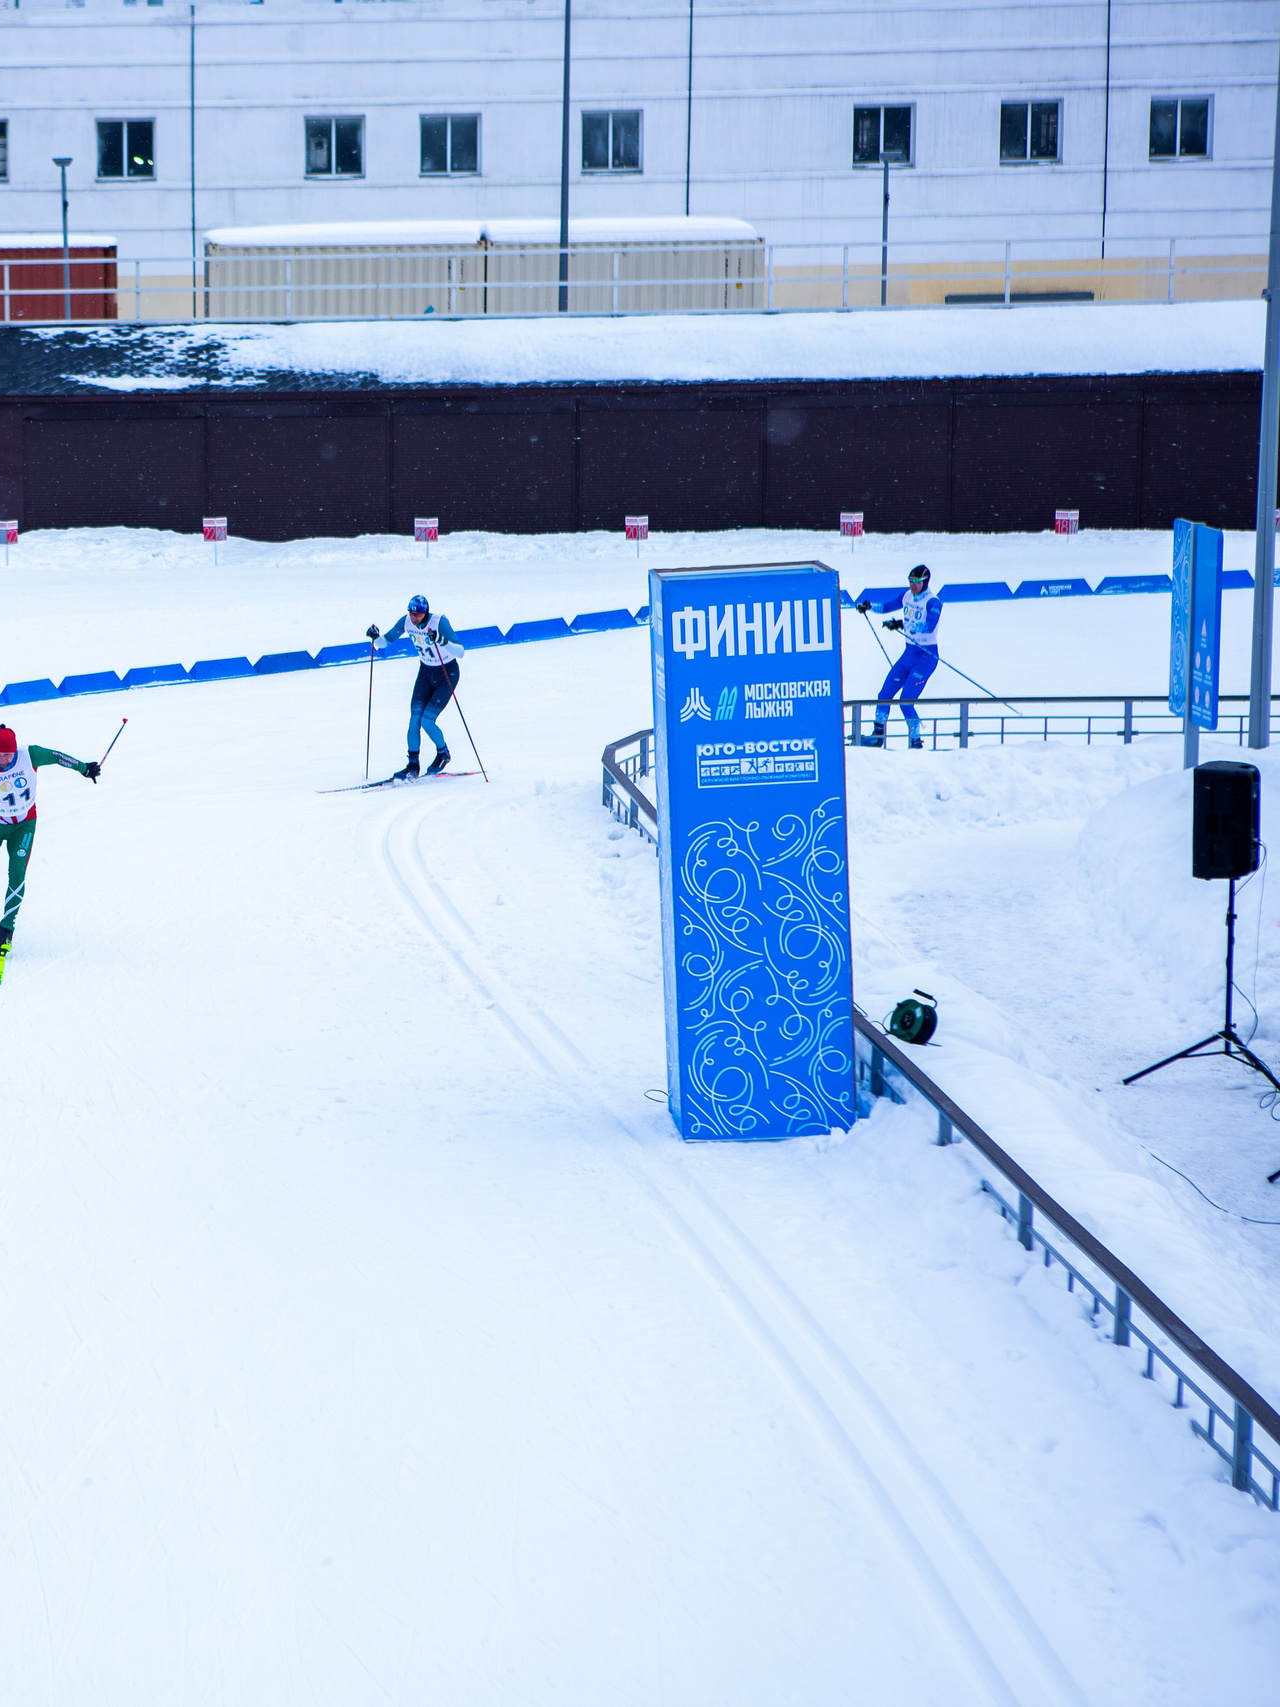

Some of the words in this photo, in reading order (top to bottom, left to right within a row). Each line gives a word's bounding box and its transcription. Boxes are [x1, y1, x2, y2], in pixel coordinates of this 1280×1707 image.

[203, 527, 215, 541] 22
[216, 526, 227, 541] 21
[416, 527, 427, 541] 21
[626, 525, 638, 540] 20
[841, 522, 853, 536] 19
[1056, 519, 1069, 534] 18
[672, 598, 833, 659] ФИНИШ
[744, 680, 831, 701] МОСКОВСКАЯ
[744, 700, 794, 719] ЛЫЖНЯ
[696, 738, 816, 756] ЮГО-ВОСТОК
